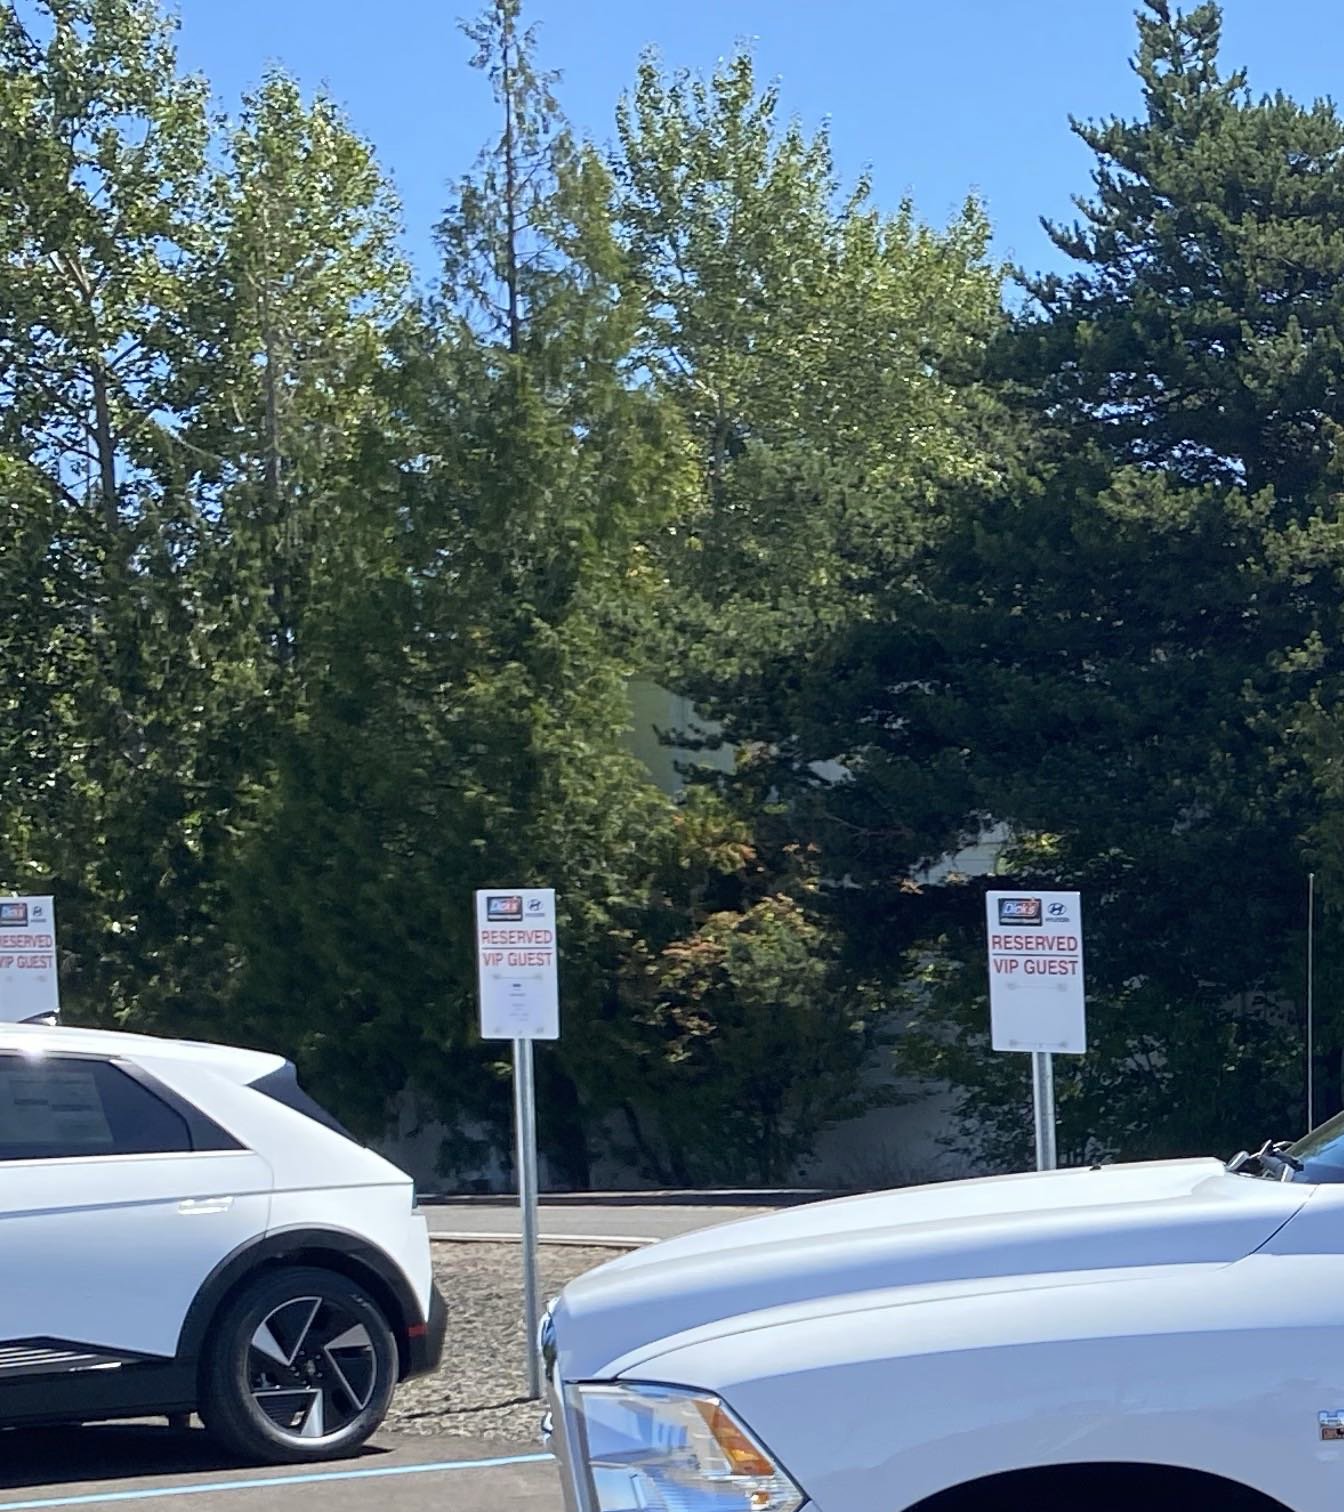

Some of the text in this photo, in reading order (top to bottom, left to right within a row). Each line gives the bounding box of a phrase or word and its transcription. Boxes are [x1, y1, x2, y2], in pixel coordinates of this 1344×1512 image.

[0, 935, 53, 948] ESERVED
[481, 930, 553, 945] RESERVED
[992, 935, 1078, 951] RESERVED
[17, 955, 53, 969] GUEST
[482, 952, 553, 967] VIP GUEST
[993, 959, 1078, 975] VIP GUEST
